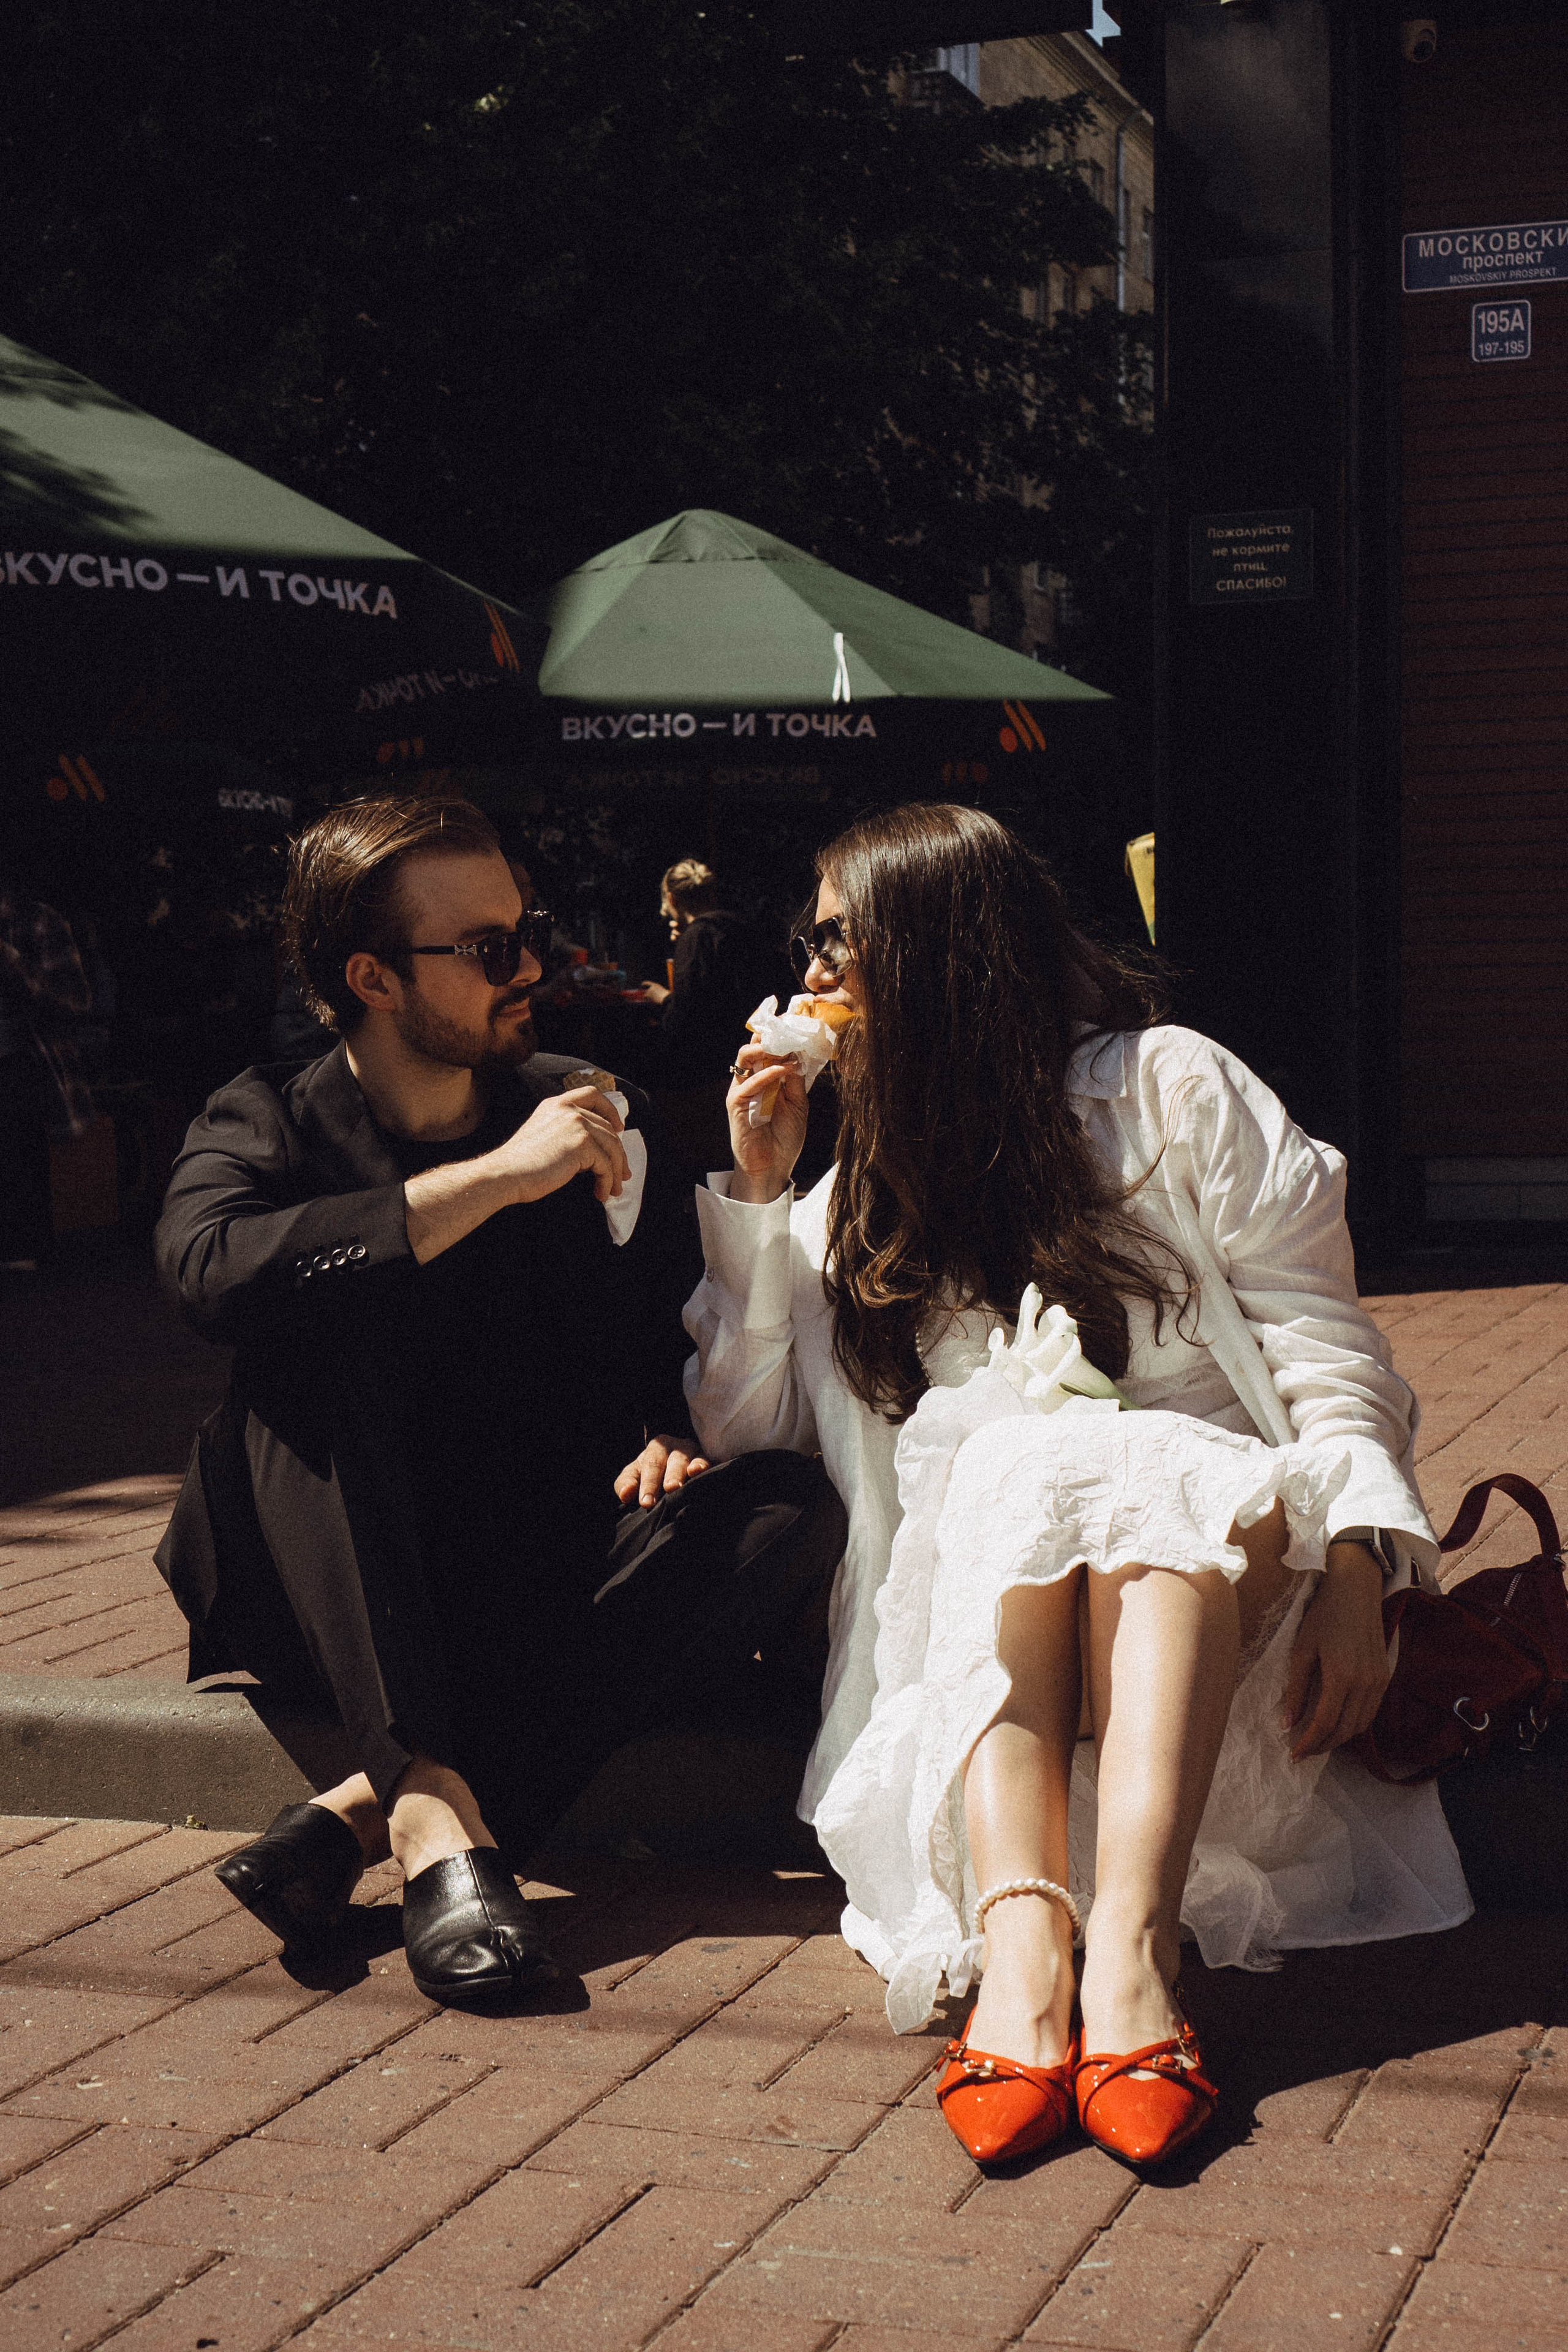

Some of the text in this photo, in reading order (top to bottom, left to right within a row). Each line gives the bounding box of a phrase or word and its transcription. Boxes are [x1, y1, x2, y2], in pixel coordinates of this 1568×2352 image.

[1463, 251, 1544, 273] проспект
[1449, 267, 1558, 284] MOSKOVSKIY PROSPEKT
[1478, 308, 1525, 334] 195А
[1478, 340, 1525, 356] 197-195
[1212, 543, 1291, 557] не кормите
[0, 551, 168, 592] КУСНО
[258, 570, 398, 619] ТОЧКА
[1216, 576, 1287, 592] СПАСИБО!
[560, 712, 698, 741] ВКУСНО
[766, 712, 878, 738] ТОЧКА
